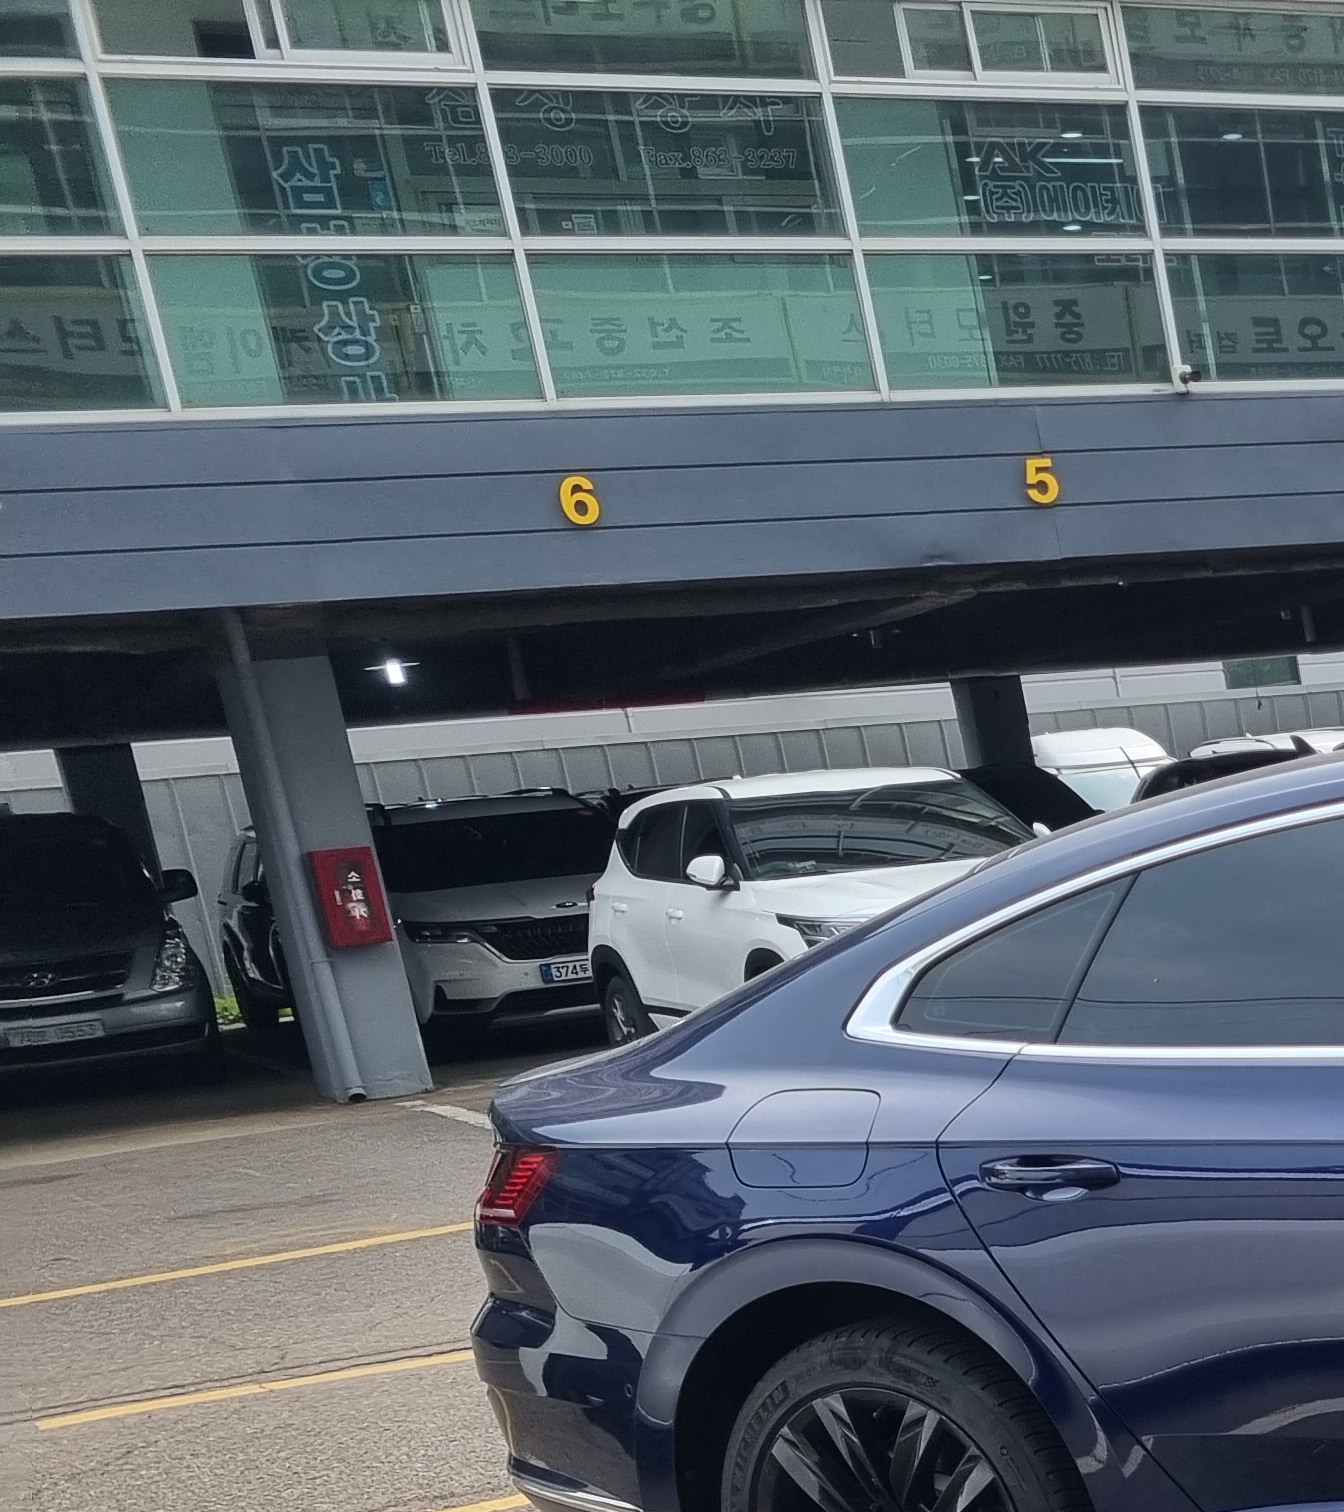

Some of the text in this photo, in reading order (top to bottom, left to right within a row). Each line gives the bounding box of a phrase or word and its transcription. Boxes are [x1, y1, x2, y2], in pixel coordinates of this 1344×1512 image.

[424, 142, 594, 167] Tel.83-3000
[976, 137, 1061, 177] AK
[558, 475, 600, 526] 6
[1025, 457, 1060, 504] 5
